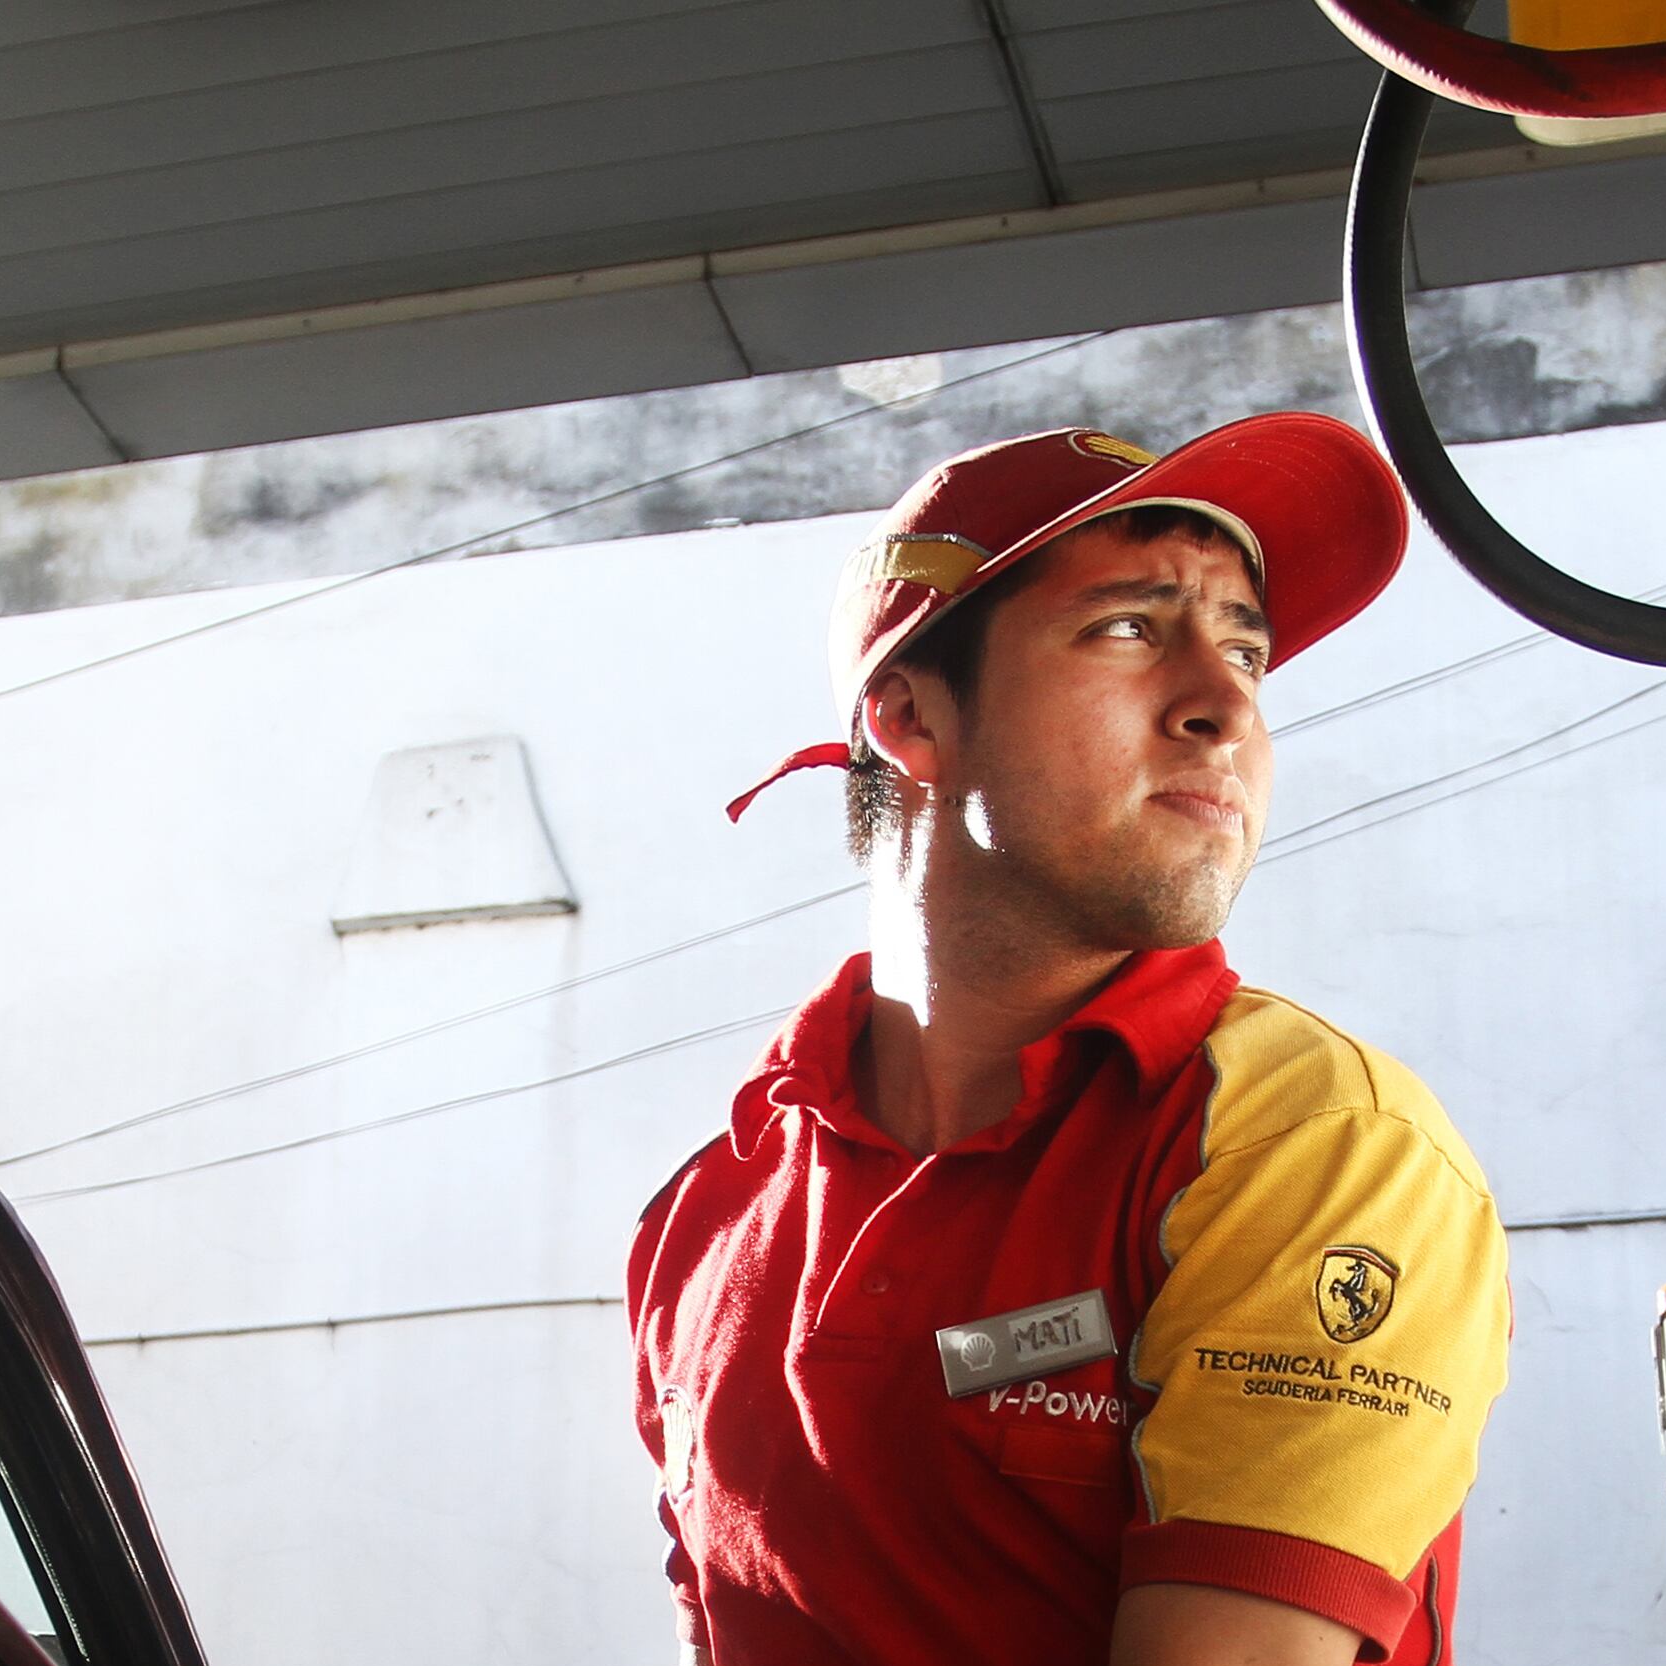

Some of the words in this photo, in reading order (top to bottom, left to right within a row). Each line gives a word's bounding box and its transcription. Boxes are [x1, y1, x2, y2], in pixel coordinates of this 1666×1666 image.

[1194, 1348, 1342, 1381] TECHNICAL
[1350, 1364, 1452, 1416] PARTNER
[1242, 1379, 1333, 1402] SCUDERIA
[1337, 1386, 1410, 1418] FERRARI
